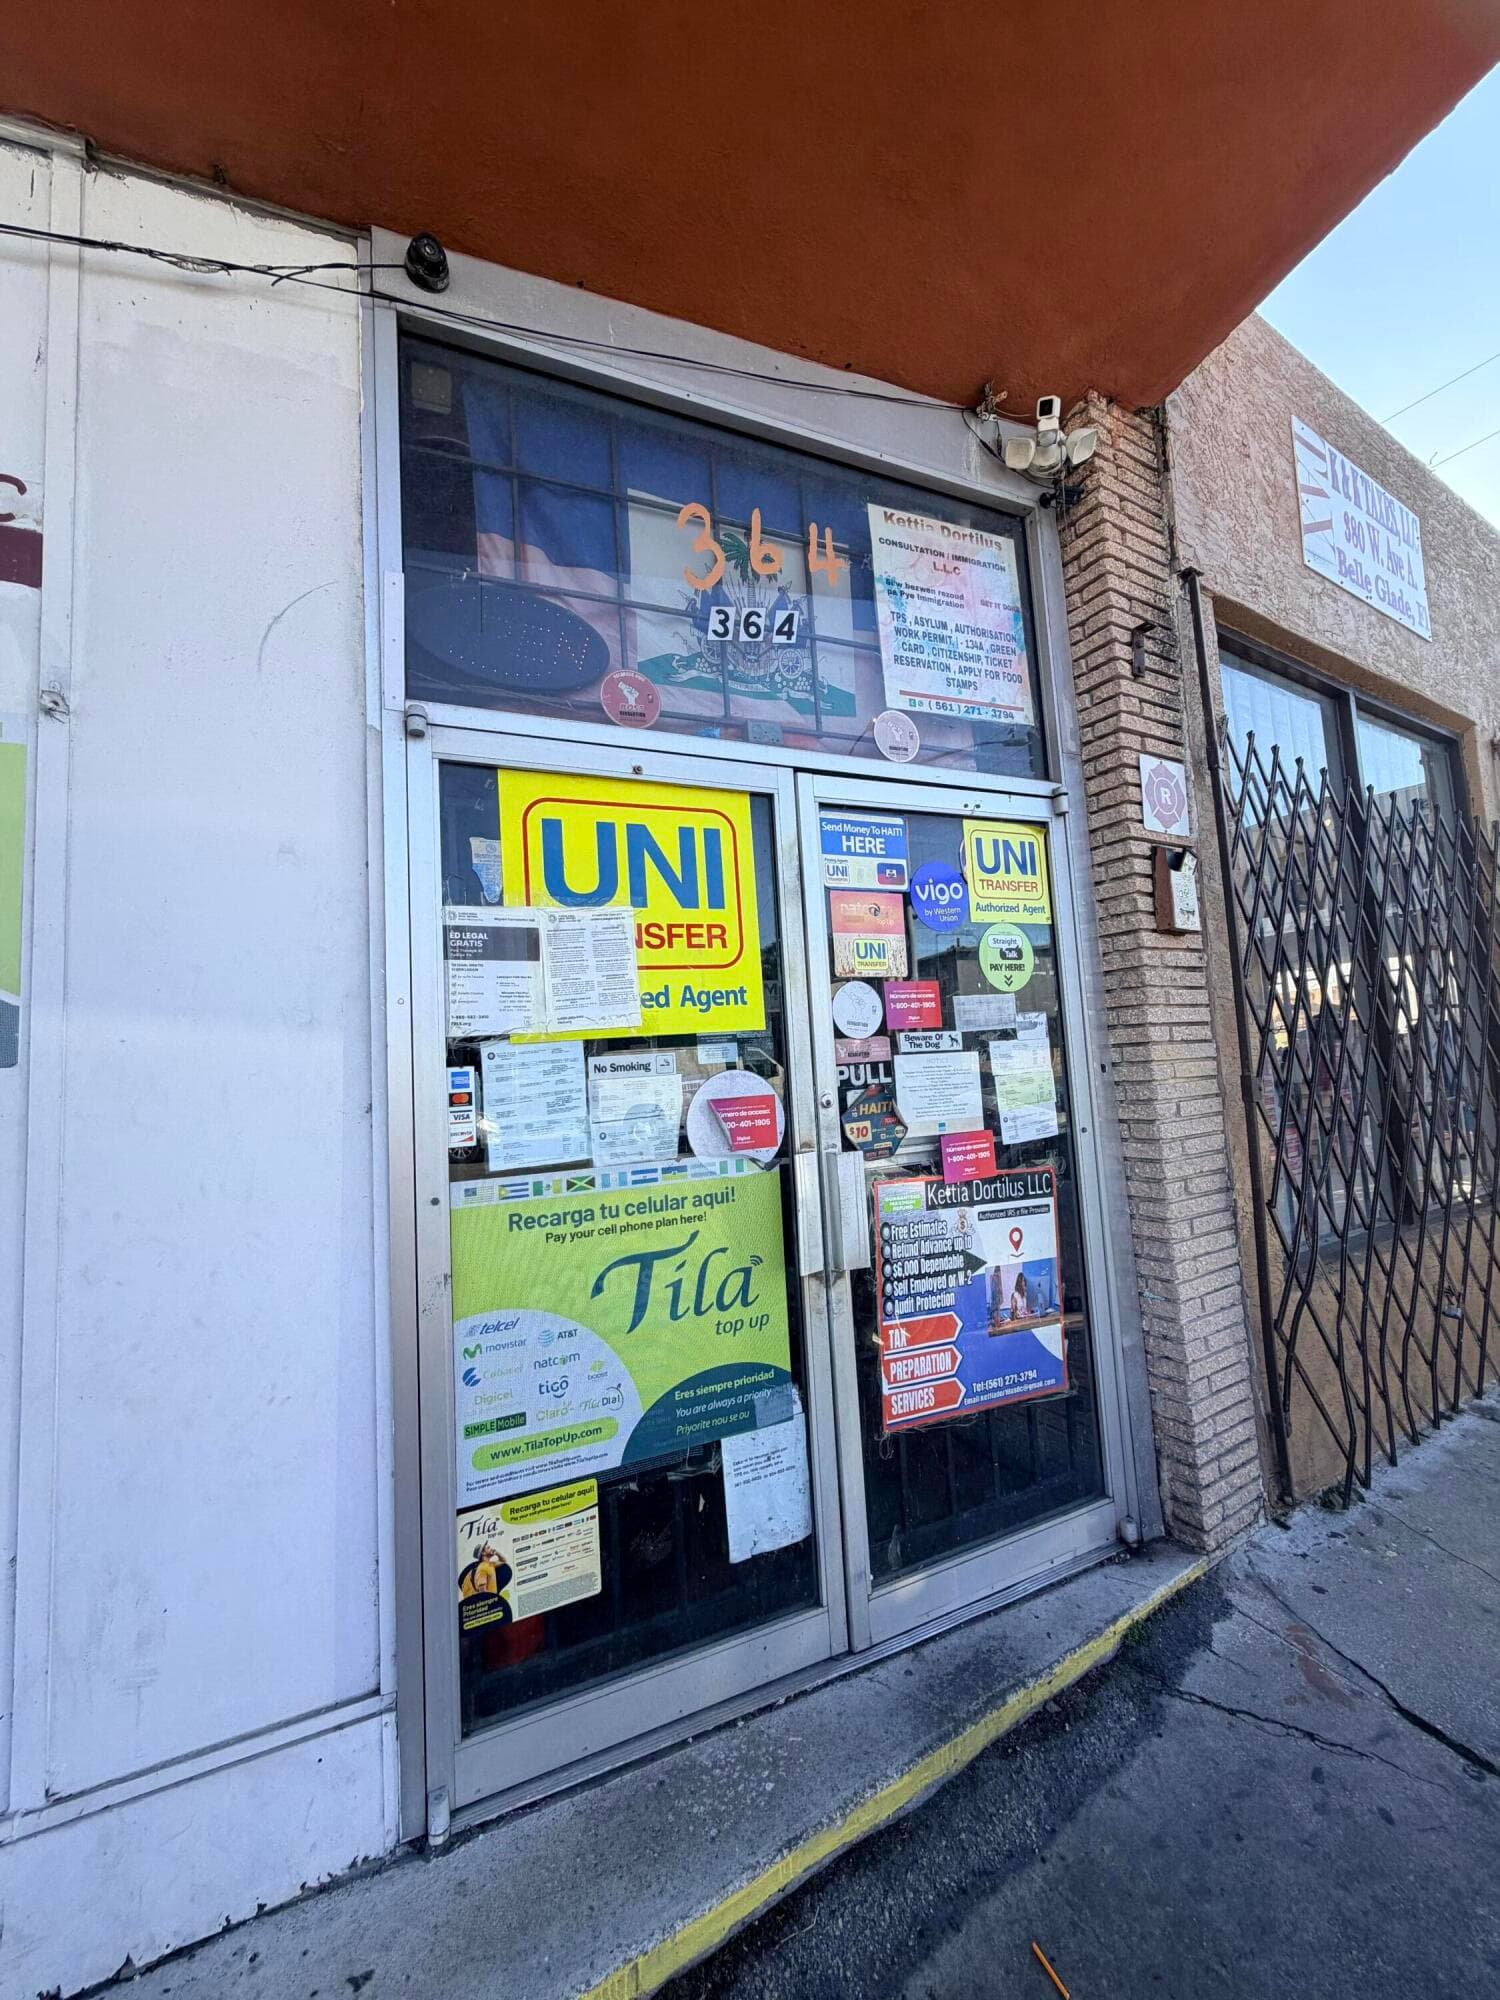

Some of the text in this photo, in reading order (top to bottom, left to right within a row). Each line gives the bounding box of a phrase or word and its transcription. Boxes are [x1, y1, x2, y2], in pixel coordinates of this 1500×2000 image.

[1328, 448, 1362, 510] K&K
[883, 511, 1002, 551] Kettia Dortilus
[677, 503, 849, 590] 364
[879, 537, 1006, 572] CONSULTATION IMMIGRATION
[1386, 536, 1405, 581] Ave
[905, 580, 964, 601] bezwen rezoud
[1336, 546, 1416, 626] Belle Glade,
[916, 594, 964, 610] Immigration
[711, 608, 796, 641] 364
[890, 611, 1016, 643] TPS ASYLUM AUTHORISATION
[894, 626, 920, 640] WORK
[990, 644, 1016, 656] GREEN
[902, 642, 924, 654] CARD
[986, 656, 1013, 669] TICKET
[894, 654, 1022, 684] RESERVATION APPLY FOR FOOD
[946, 678, 978, 691] STAMPS
[964, 704, 982, 716] 271
[991, 708, 1014, 720] 3794
[1160, 788, 1172, 804] R
[822, 823, 843, 832] Send
[844, 824, 870, 836] Money
[842, 836, 886, 854] HERE
[542, 818, 725, 909] UNI
[975, 838, 1037, 876] UNI
[826, 864, 848, 877] UNI
[915, 878, 963, 904] vigo
[980, 878, 1038, 892] TRANSFER
[924, 906, 961, 916] by Western
[976, 902, 1046, 916] Authorized Agent
[450, 939, 483, 948] GRATIS
[462, 932, 488, 940] LEGAL
[992, 938, 1018, 947] Straight
[856, 943, 886, 959] UNI
[1004, 949, 1018, 958] Talk
[990, 964, 1004, 972] PAY
[680, 986, 748, 1012] Agent
[904, 1034, 932, 1043] Beware
[926, 1041, 940, 1050] Dog
[594, 1062, 651, 1073] No Smoking
[838, 1066, 892, 1086] PULL
[849, 1124, 868, 1138] $10
[928, 1174, 1052, 1206] Kettia Dortilus LLC
[509, 1186, 735, 1232] Recarga tu celular aqui!
[546, 1213, 706, 1244] Pay your cell phone plan here!
[892, 1220, 947, 1240] Free Estimates
[892, 1235, 972, 1259] Refund Advance up to
[921, 1253, 964, 1274] Dependable
[590, 1230, 759, 1334] Tila
[894, 1270, 972, 1296] Self Employed or W-2
[894, 1292, 955, 1315] Audit Protection
[480, 1317, 520, 1335] telcel
[557, 1329, 578, 1340] AT&T
[715, 1314, 769, 1337] top up
[486, 1338, 527, 1353] movistar
[888, 1328, 907, 1348] TAX
[890, 1351, 951, 1382] PREPARATION
[1005, 1369, 1037, 1386] 271-3794
[674, 1369, 774, 1401] Eres siempre prioridad
[601, 1394, 621, 1407] Dial
[676, 1389, 772, 1418] You are always a priority
[891, 1388, 935, 1415] SERVICES
[465, 1414, 525, 1437] SIMPLE Mobile
[676, 1411, 750, 1435] Priyorite nou se ou
[490, 1426, 602, 1461] www.TilaTopUp.com
[509, 1502, 541, 1515] Recarga
[551, 1493, 576, 1504] celular
[460, 1516, 498, 1540] Tila
